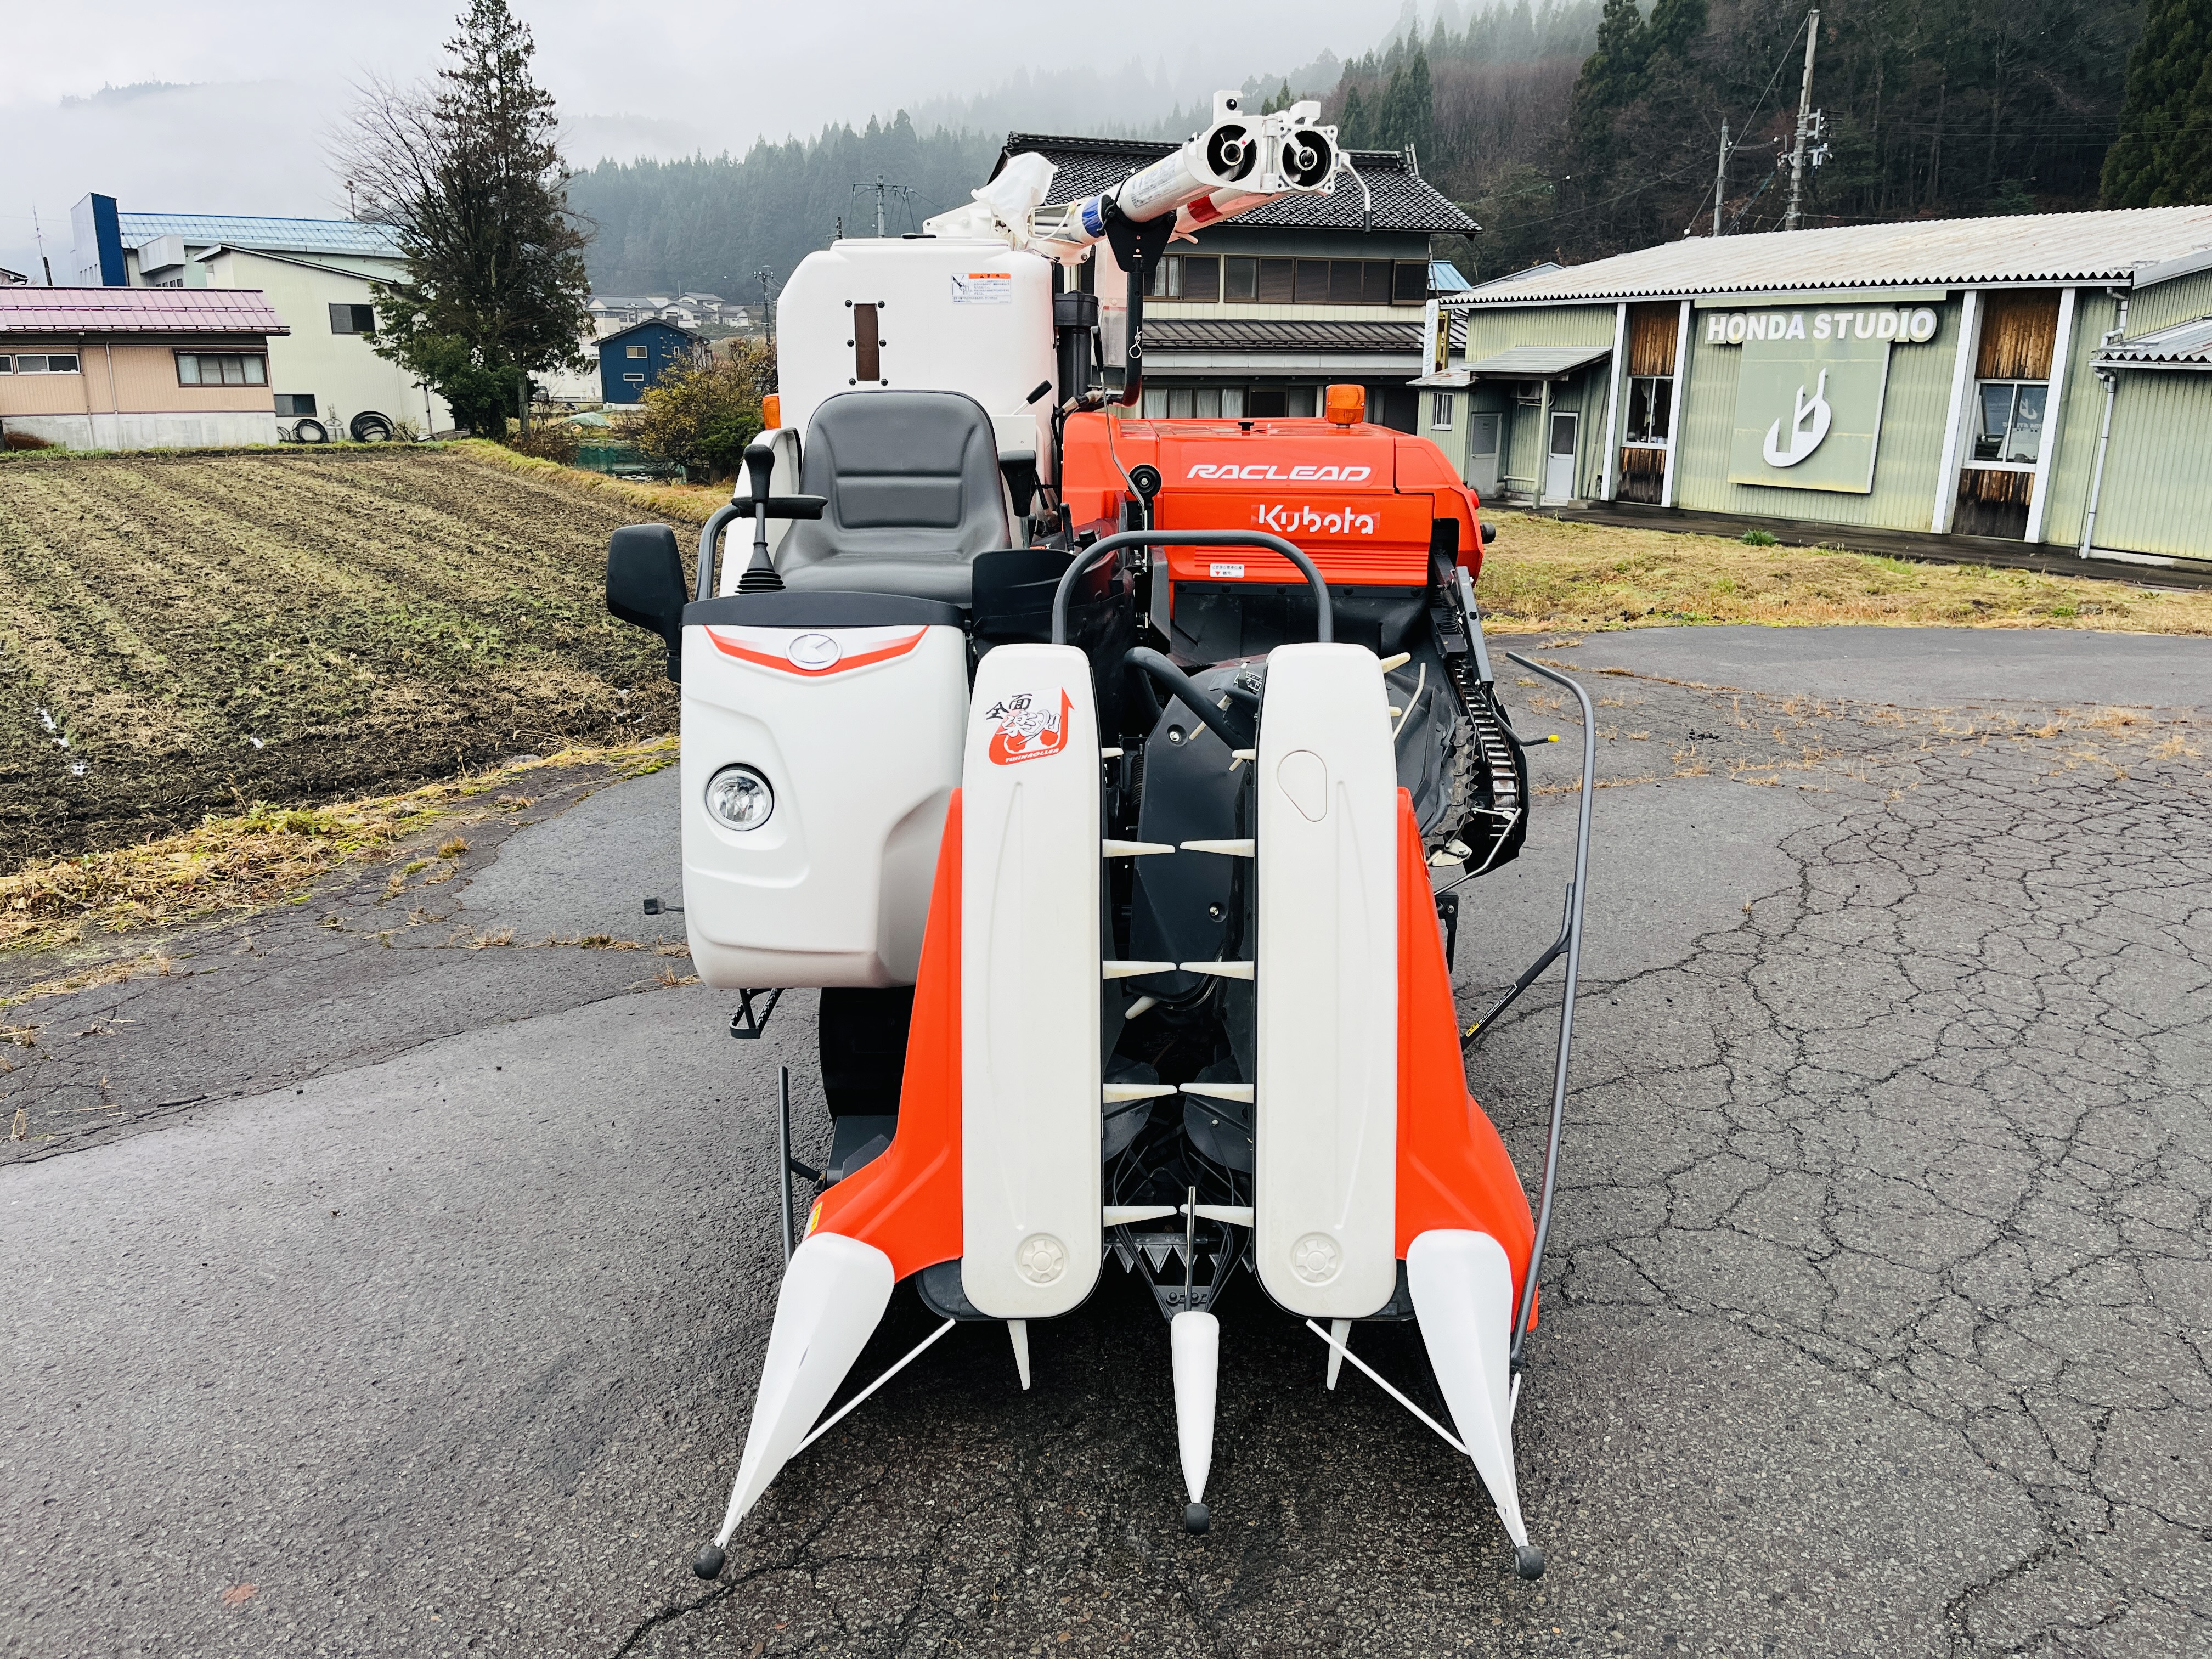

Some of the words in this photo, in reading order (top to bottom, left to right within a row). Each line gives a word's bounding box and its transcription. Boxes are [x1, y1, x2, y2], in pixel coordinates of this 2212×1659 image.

[1705, 313, 1805, 343] HONDA
[1812, 308, 1937, 342] STUDIO
[1186, 464, 1372, 481] RACLEAD
[1258, 504, 1374, 534] Kubota
[985, 693, 1032, 720] 全面
